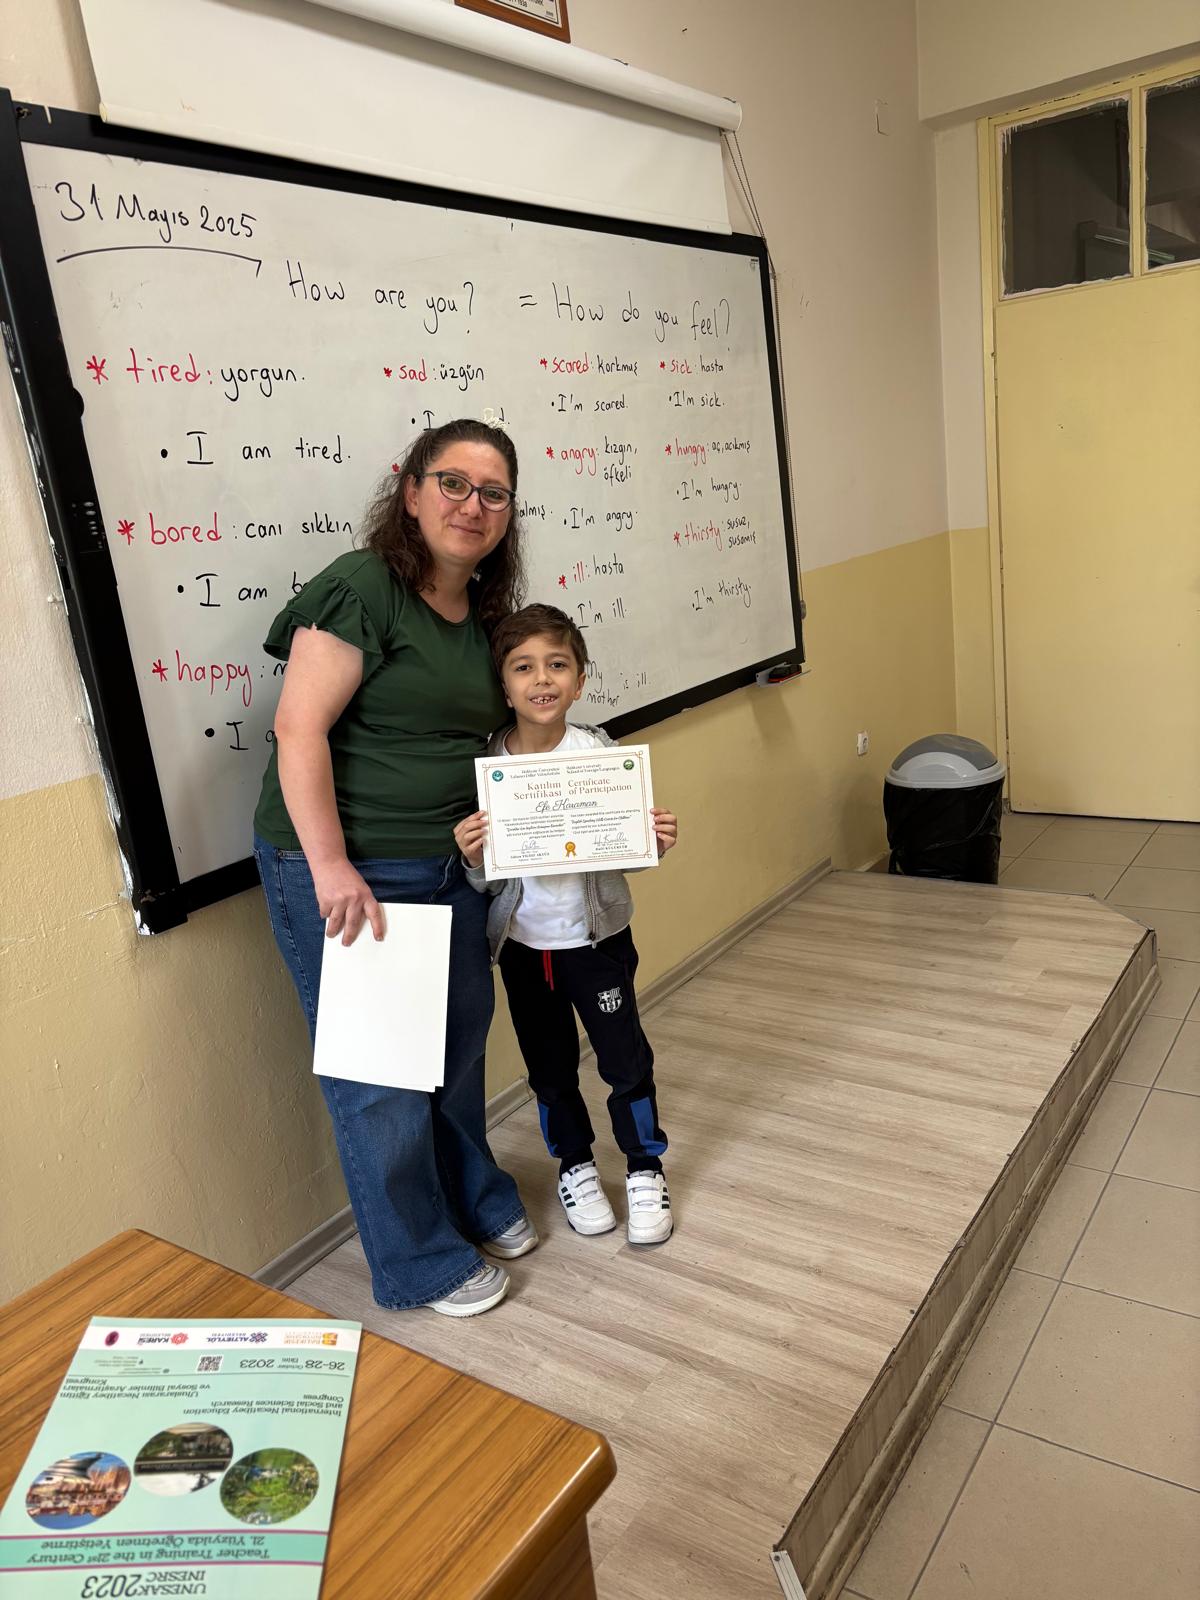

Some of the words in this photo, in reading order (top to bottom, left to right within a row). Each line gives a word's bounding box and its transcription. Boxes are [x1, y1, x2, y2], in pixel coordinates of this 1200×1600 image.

[55, 182, 102, 222] 31
[200, 206, 256, 238] 2025
[287, 260, 345, 301] How
[374, 287, 406, 310] are
[424, 281, 474, 334] you?
[552, 282, 604, 322] How
[621, 291, 640, 323] do
[654, 311, 679, 343] you
[691, 298, 731, 351] feel?
[596, 354, 638, 376] korkmuş
[699, 354, 724, 372] hasta
[220, 364, 305, 402] yorgun.
[439, 363, 485, 391] üzgün
[558, 394, 583, 412] I'm
[594, 394, 628, 411] scared.
[673, 390, 695, 407] I'm
[701, 391, 725, 407] sick.
[186, 430, 214, 465] I
[242, 442, 271, 459] am
[295, 435, 352, 463] tired.
[682, 479, 702, 500] I'm
[711, 477, 742, 503] hungry.
[519, 501, 552, 520] almış.
[570, 507, 595, 529] I'm
[606, 510, 638, 531] angry.
[593, 553, 624, 575] hasta
[195, 573, 221, 607] I
[238, 584, 268, 601] am
[695, 586, 714, 612] I'm
[577, 600, 603, 629] I'm
[612, 597, 627, 619] ill.
[226, 721, 249, 751] I
[567, 778, 610, 788] Certificate
[568, 788, 578, 796] of
[579, 784, 632, 795] Participation
[240, 1359, 275, 1368] 2023
[305, 1360, 345, 1370] 26-28
[211, 1400, 254, 1408] Research
[304, 1393, 344, 1403] Congress
[233, 1407, 280, 1415] Necatibey
[280, 1408, 342, 1416] International
[26, 1553, 85, 1564] Century
[112, 1551, 135, 1561] the
[139, 1550, 153, 1559] in
[155, 1548, 213, 1560] Training
[216, 1548, 270, 1559] Teacher
[145, 1570, 206, 1581] INESRC
[81, 1574, 142, 1600] 2023
[138, 1583, 207, 1595] UNESAK
